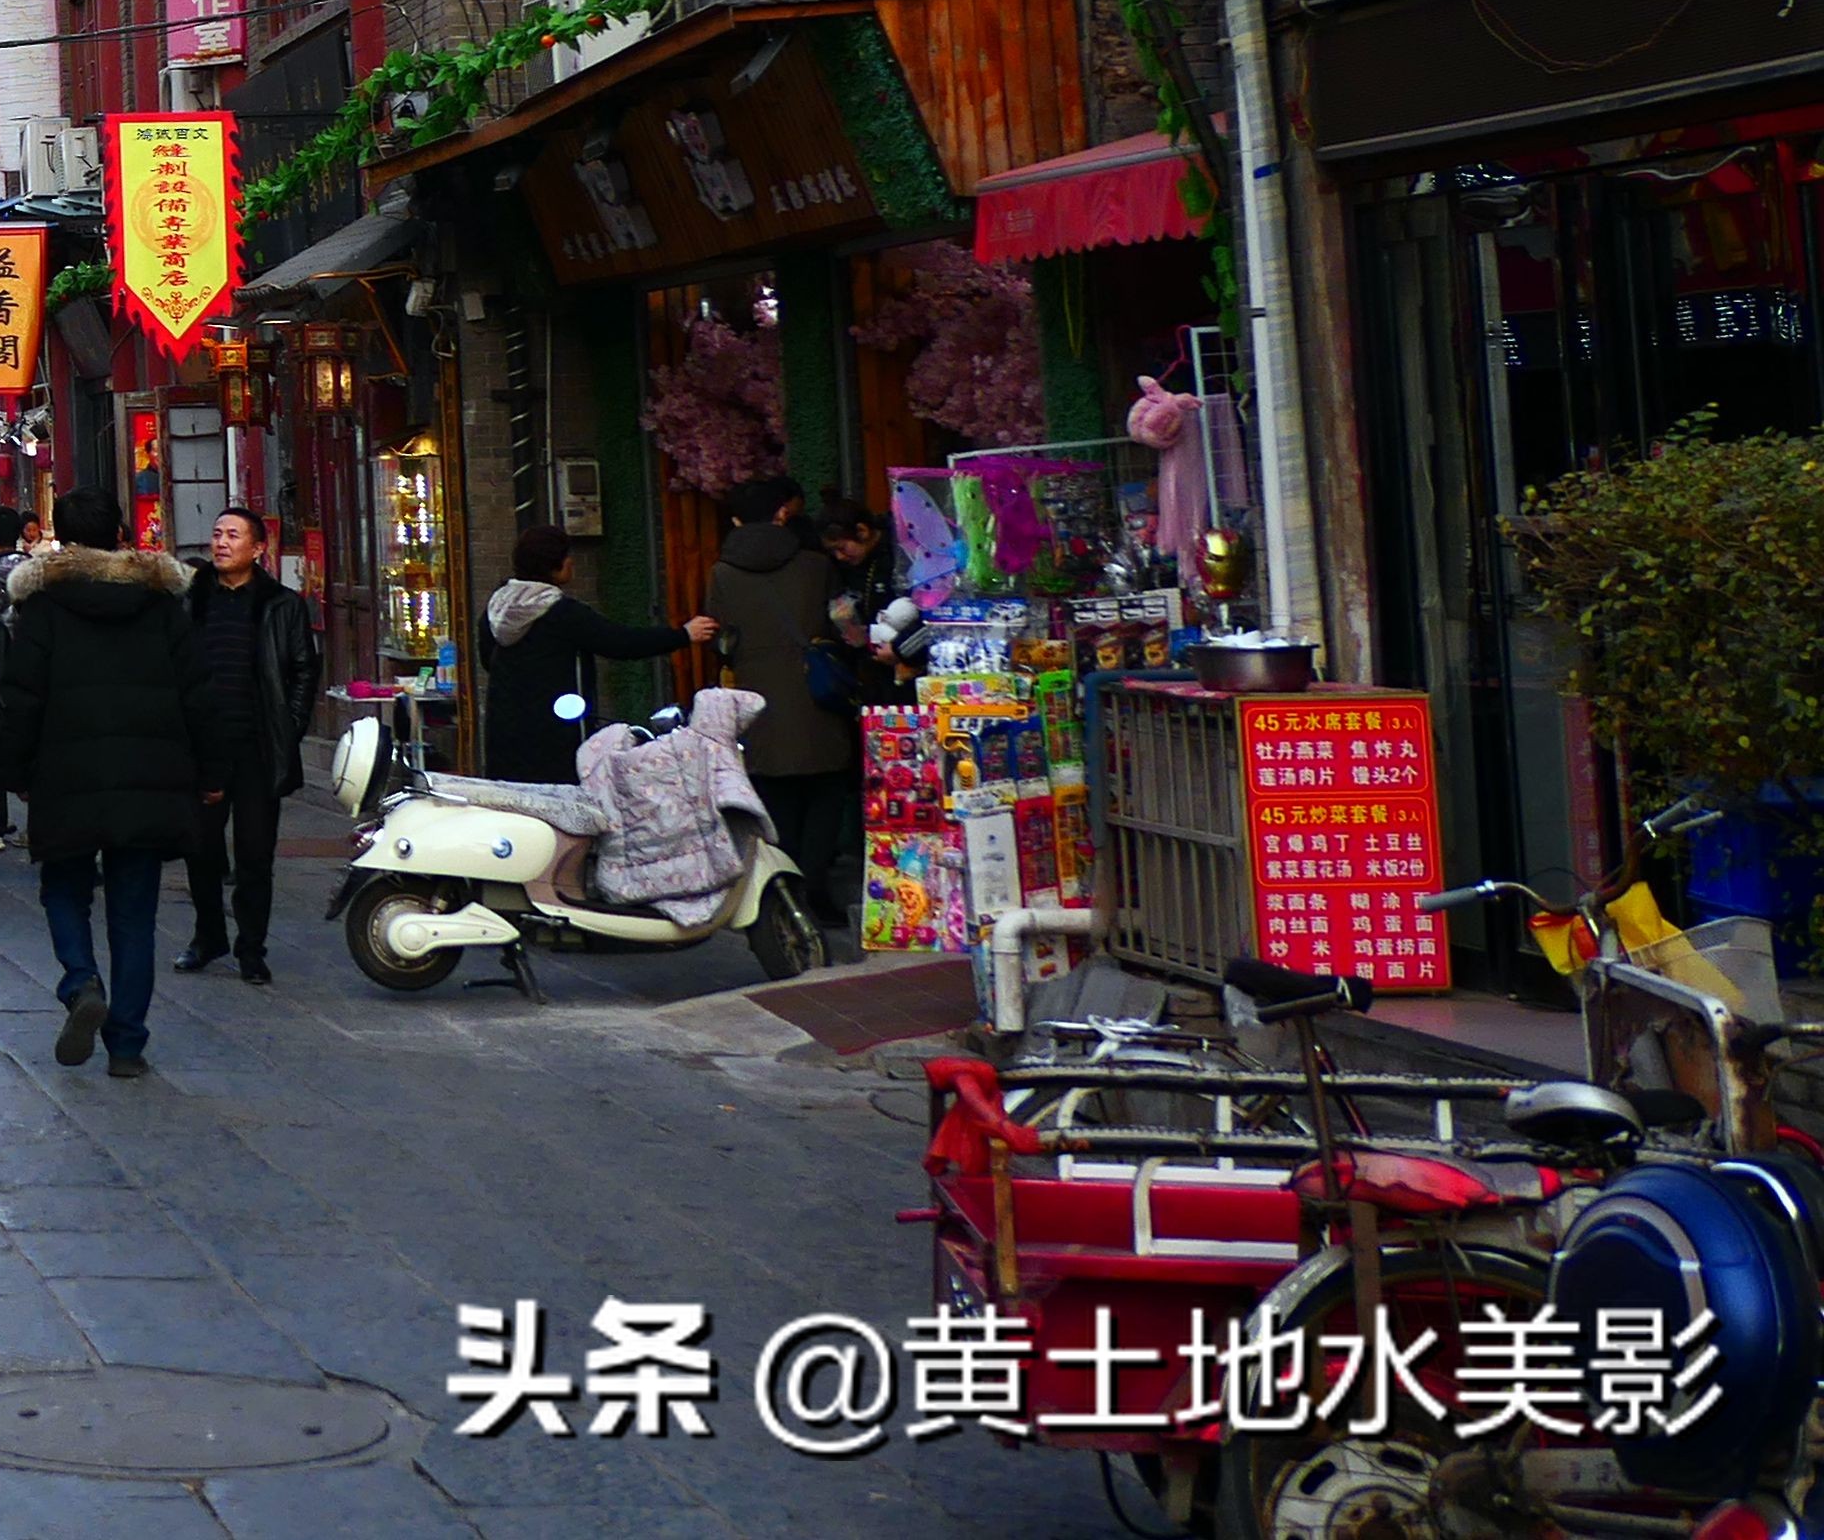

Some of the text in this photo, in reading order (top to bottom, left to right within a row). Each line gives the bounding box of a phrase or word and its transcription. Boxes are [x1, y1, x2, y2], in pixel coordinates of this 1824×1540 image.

[1256, 740, 1418, 760] 牡丹燕菜 焦炸丸
[1351, 766, 1418, 785] 馒头2个
[1365, 833, 1424, 852] 土豆丝
[1266, 859, 1425, 879] 紫菜蛋花汤 米饭2份
[1268, 915, 1434, 935] 肉丝面 鸡蛋面
[1354, 938, 1436, 957] 鸡蛋捞面
